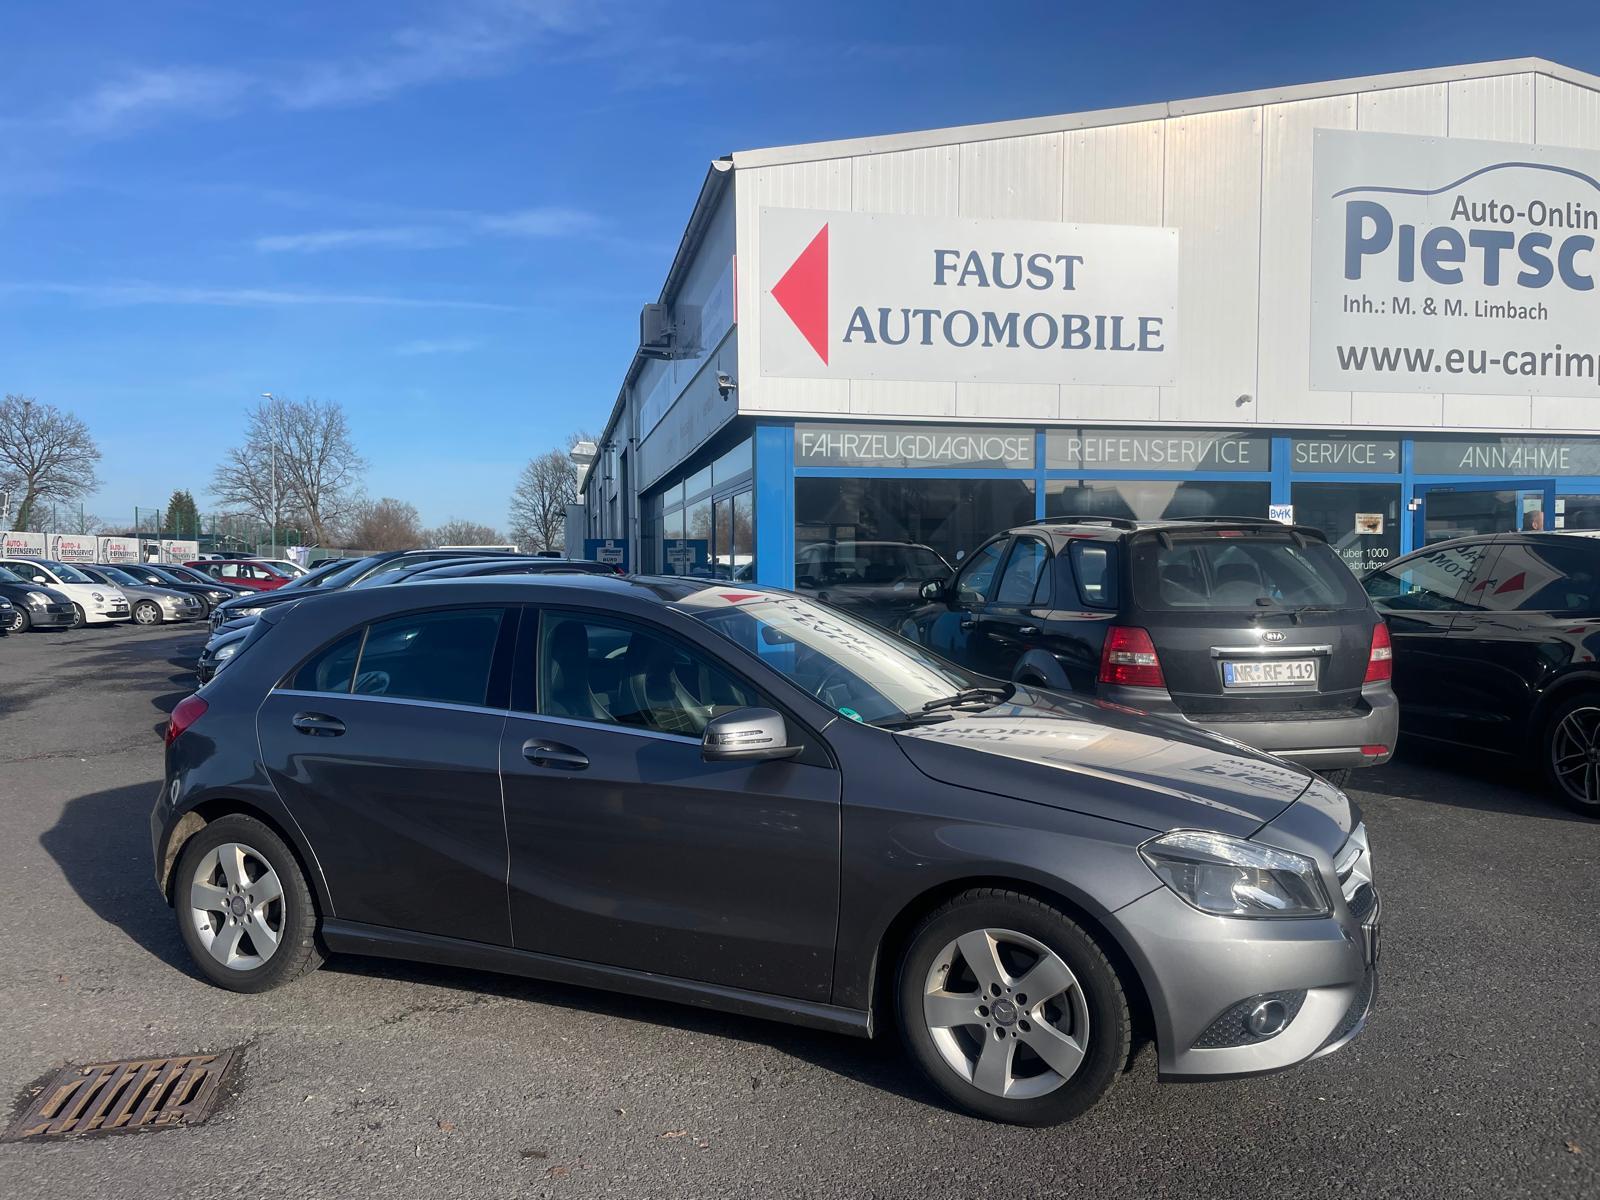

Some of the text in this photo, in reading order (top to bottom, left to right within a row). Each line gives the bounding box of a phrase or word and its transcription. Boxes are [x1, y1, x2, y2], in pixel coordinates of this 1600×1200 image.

[933, 249, 1085, 290] FAUST
[1343, 295, 1548, 320] Inh.: M. & M. Limbach
[842, 305, 1165, 352] AUTOMOBILE
[1337, 344, 1600, 386] www.eu-carim
[801, 432, 1030, 462] FAHRZEUGDIAGNOSE
[1067, 438, 1250, 464] REIFENSERVICE
[1295, 441, 1376, 464] SERVICE
[1459, 446, 1570, 469] ANNAHME
[6, 547, 42, 555] REIFENSERVICE
[1343, 548, 1364, 558] über
[1366, 548, 1389, 558] 1000
[1286, 663, 1314, 680] 119
